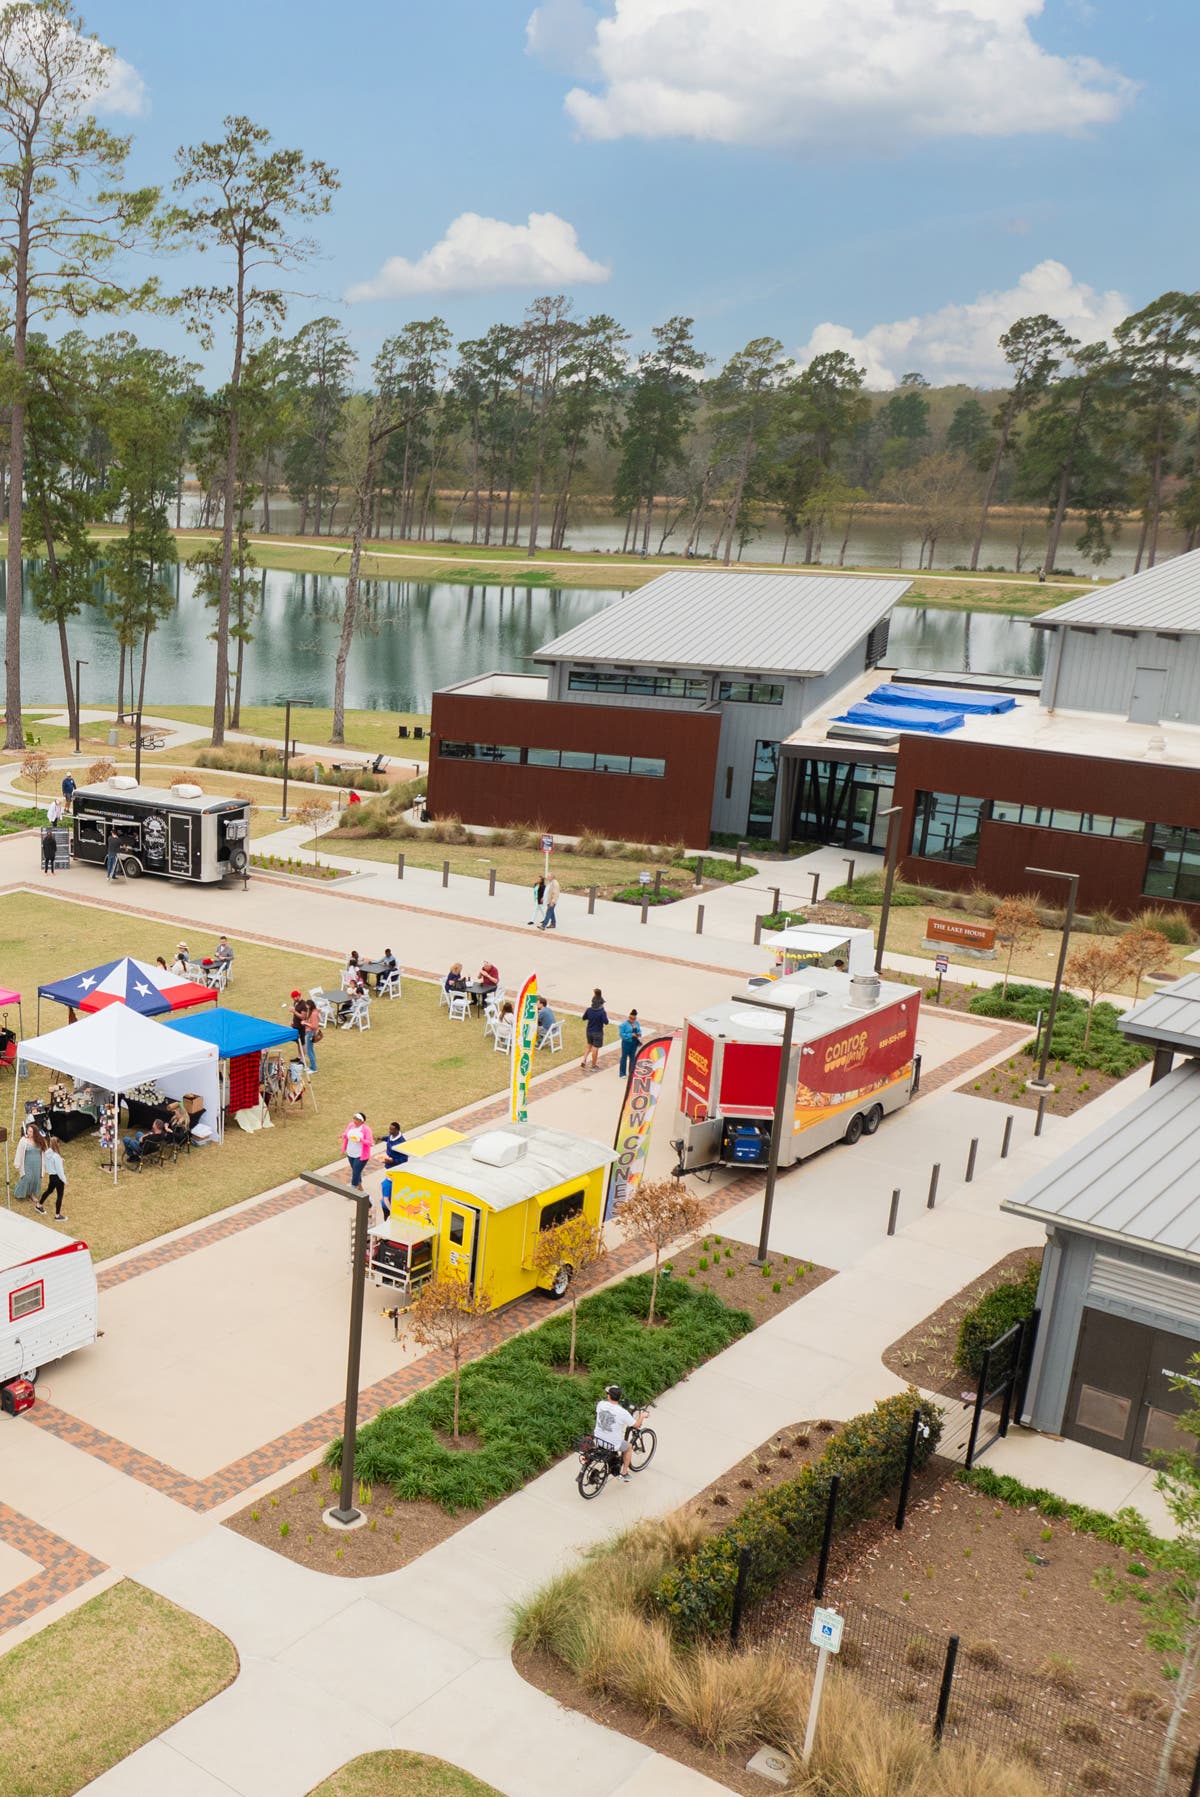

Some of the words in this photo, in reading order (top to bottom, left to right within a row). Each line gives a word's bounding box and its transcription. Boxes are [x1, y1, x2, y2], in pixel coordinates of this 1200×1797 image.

[965, 929, 986, 938] HOUSE
[825, 1031, 868, 1063] conroe
[629, 1060, 654, 1128] SNOW
